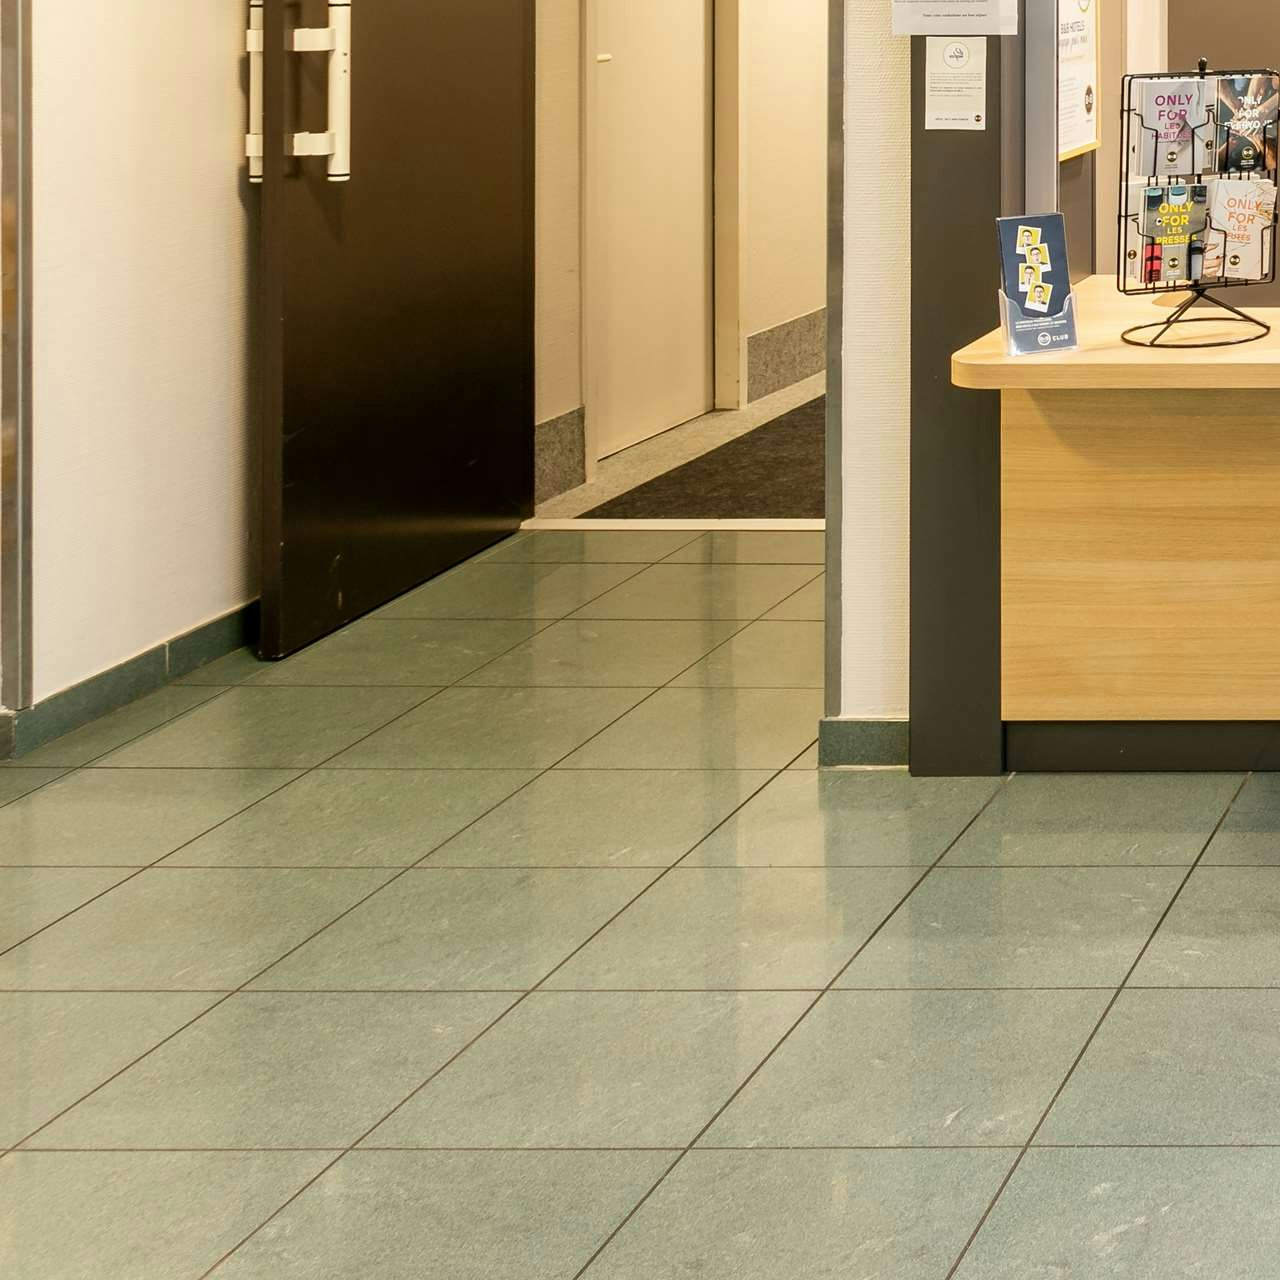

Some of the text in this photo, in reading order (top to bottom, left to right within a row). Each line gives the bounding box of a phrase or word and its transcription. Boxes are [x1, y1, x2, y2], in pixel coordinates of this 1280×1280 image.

[1155, 94, 1193, 106] ONLY
[1158, 109, 1187, 120] FOR
[1158, 201, 1194, 214] ONLY
[1227, 198, 1262, 210] ONLY
[1162, 215, 1189, 226] FOR
[1228, 212, 1255, 224] FOR
[1167, 226, 1182, 234] LES
